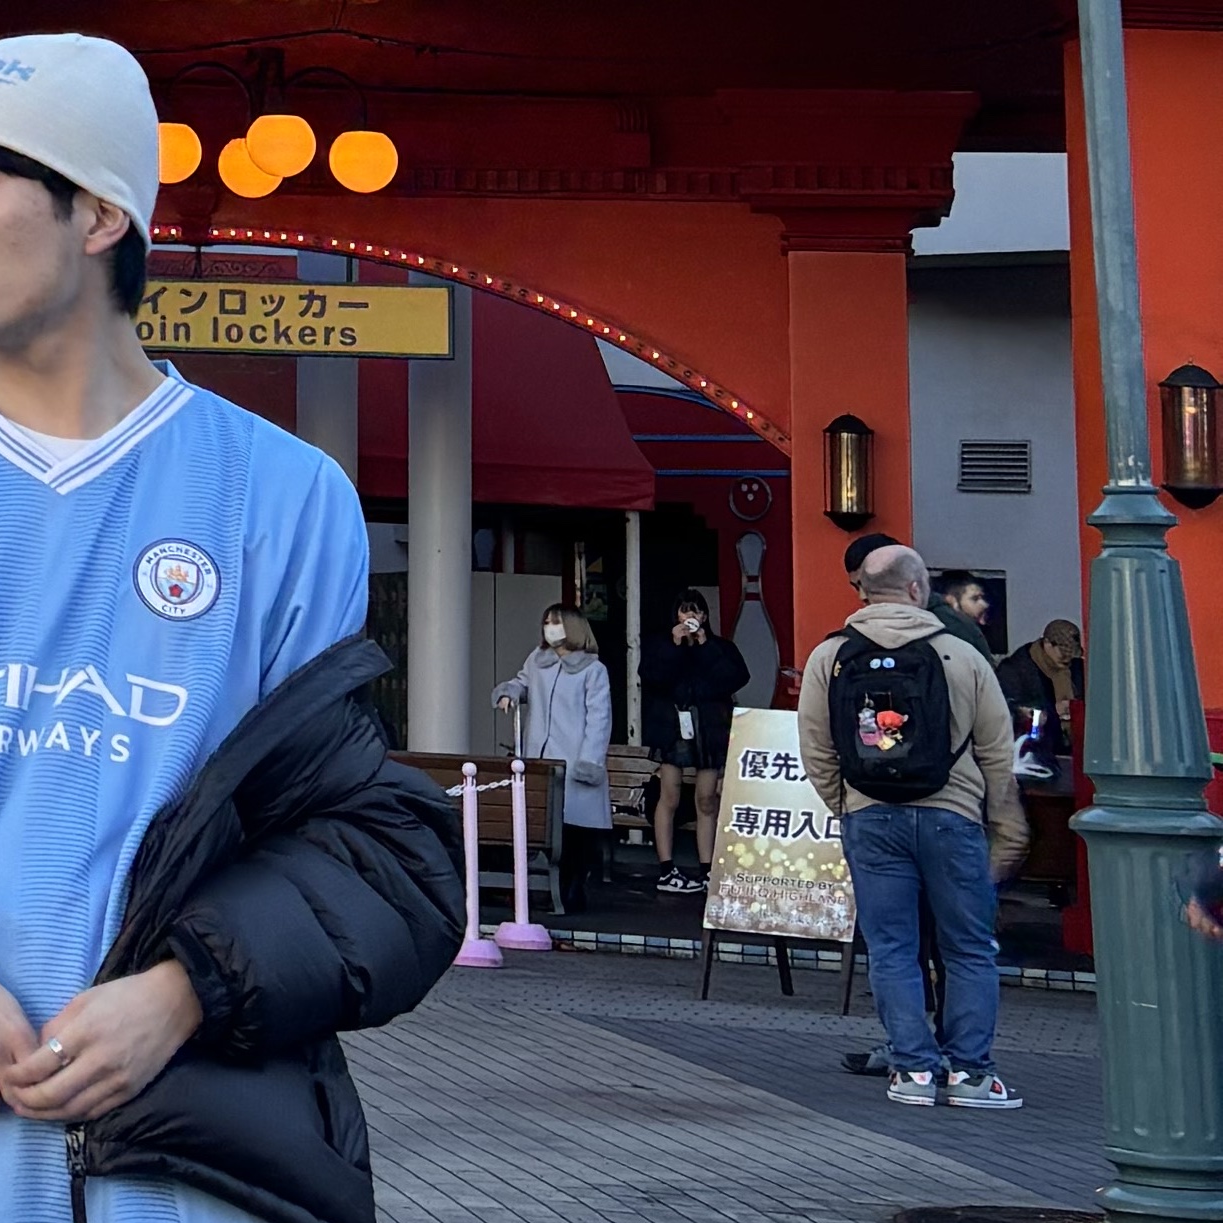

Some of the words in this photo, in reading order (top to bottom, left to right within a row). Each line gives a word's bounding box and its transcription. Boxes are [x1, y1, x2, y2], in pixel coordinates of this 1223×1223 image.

[212, 316, 358, 346] lockers
[145, 545, 213, 575] MANCHESTER
[160, 604, 186, 615] CITY
[740, 750, 808, 782] 優先
[736, 872, 815, 890] SUPPORTED
[817, 881, 835, 891] BY
